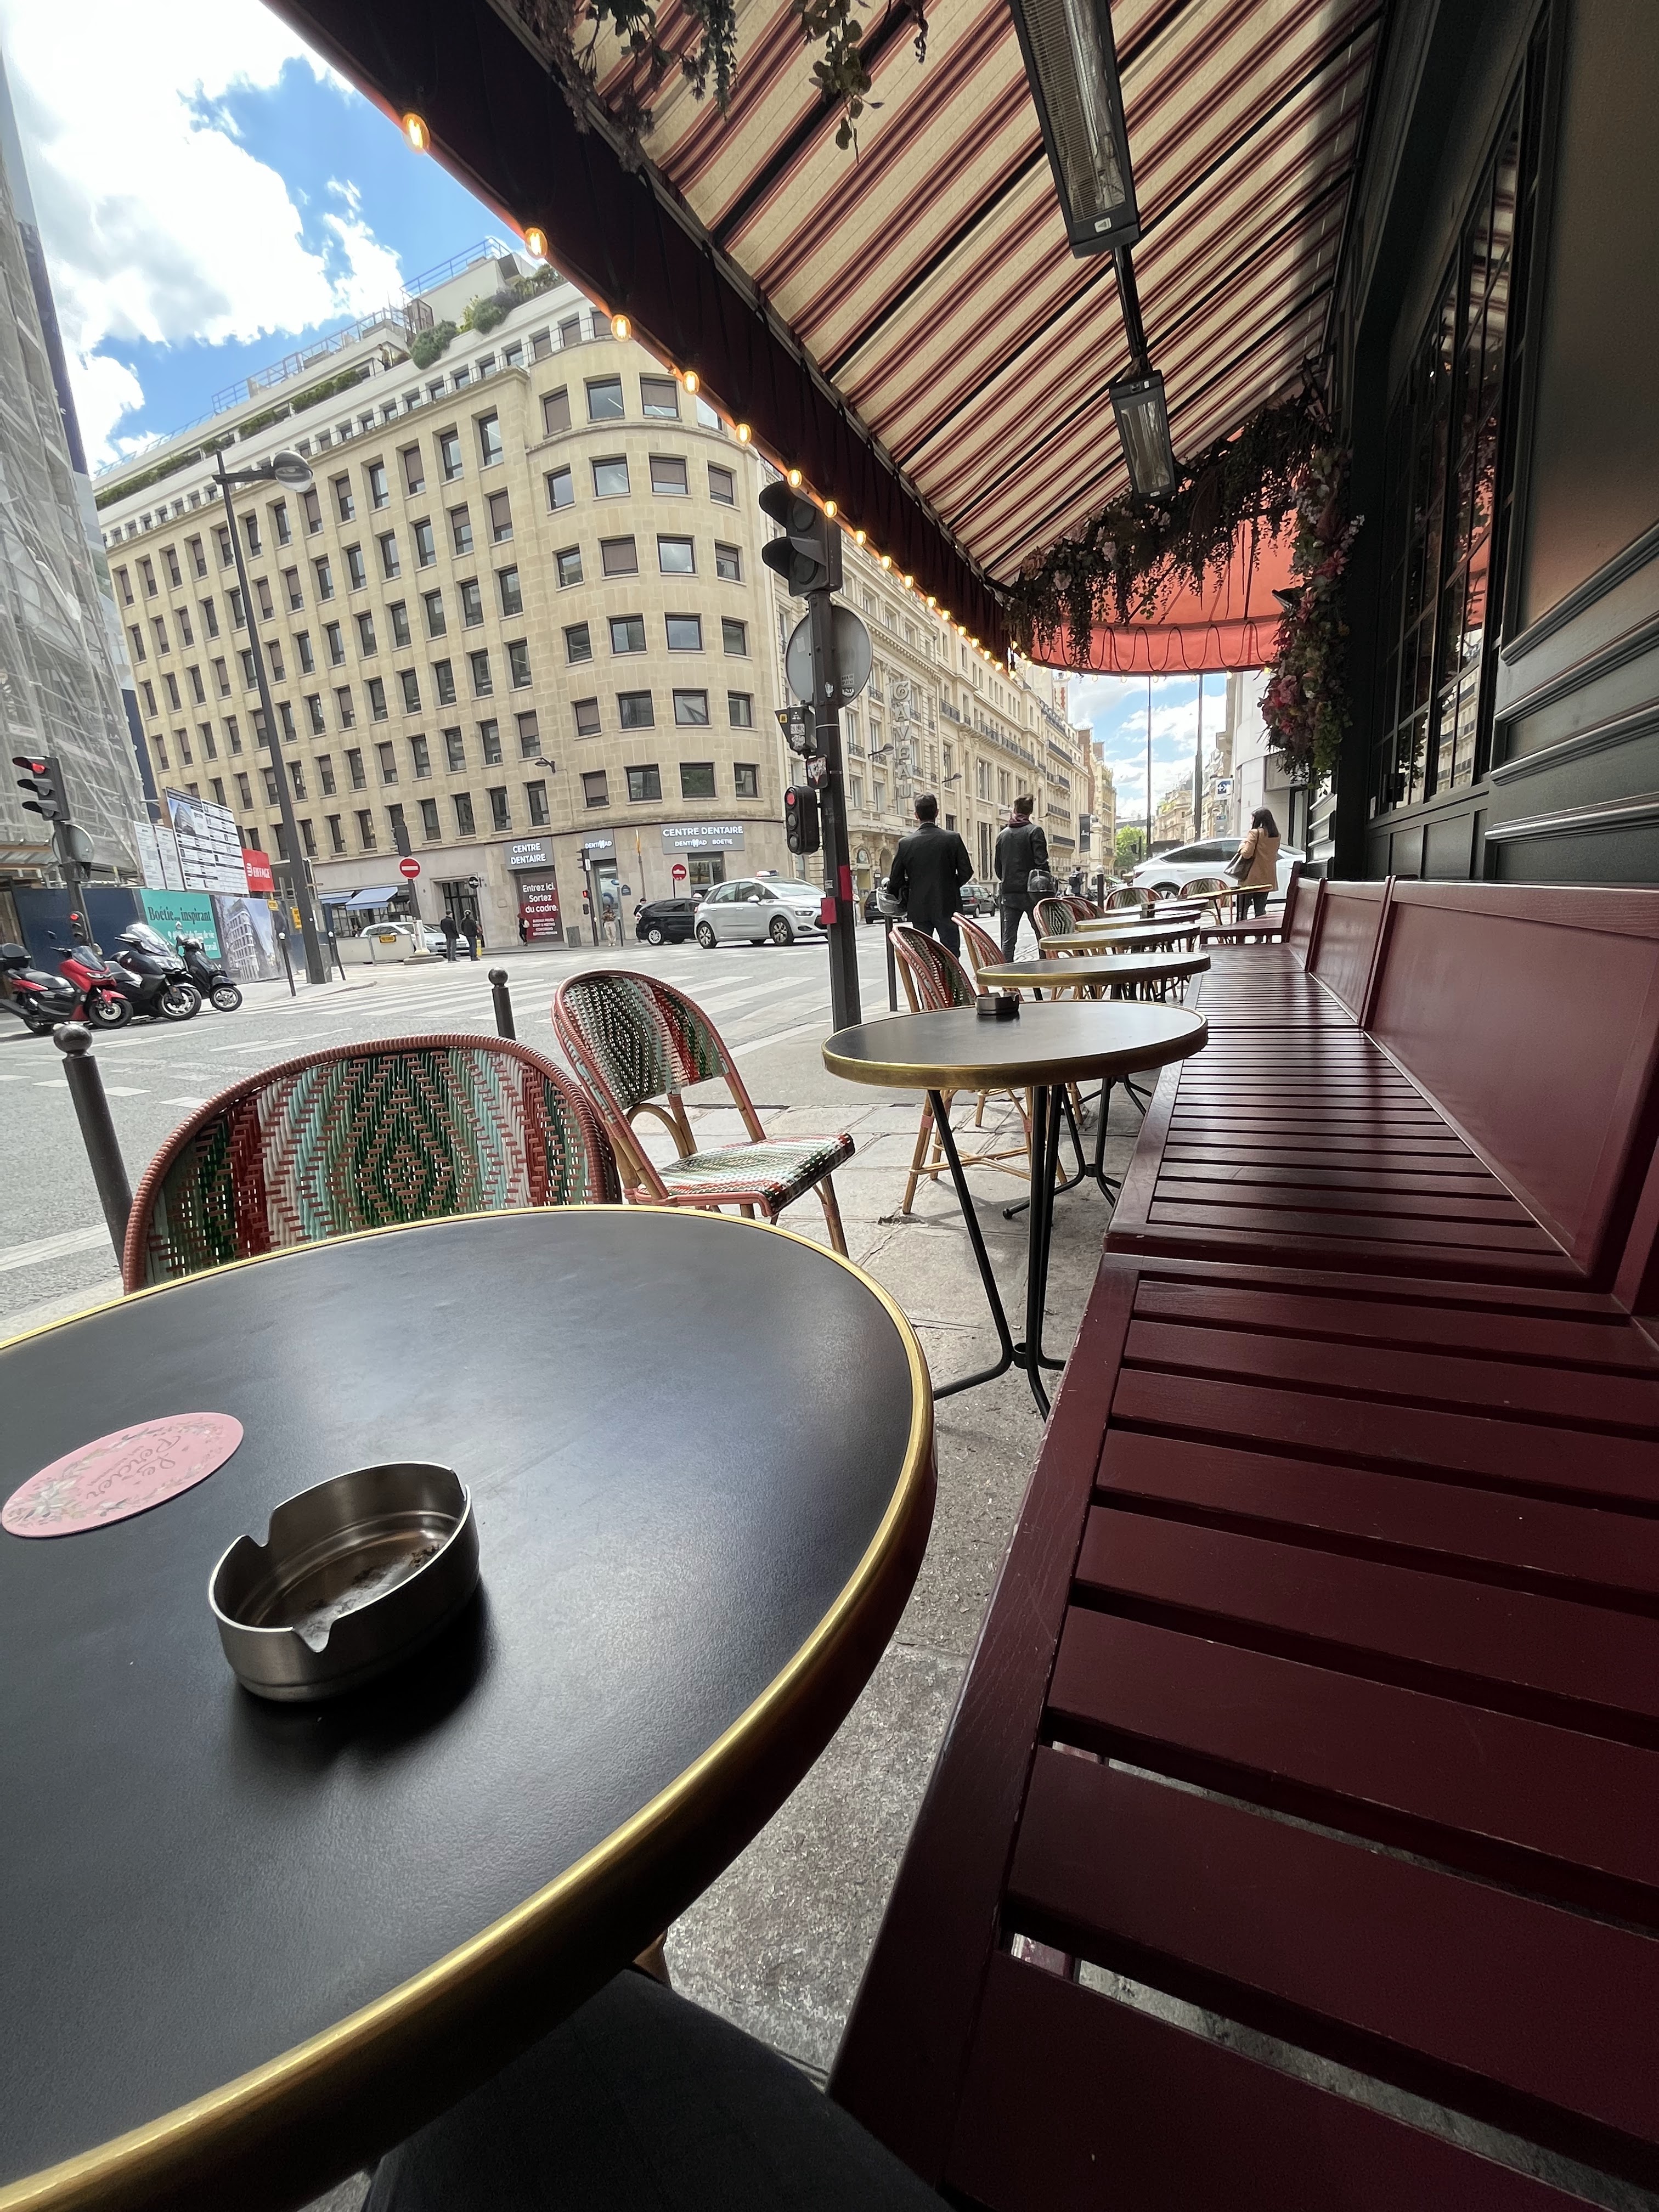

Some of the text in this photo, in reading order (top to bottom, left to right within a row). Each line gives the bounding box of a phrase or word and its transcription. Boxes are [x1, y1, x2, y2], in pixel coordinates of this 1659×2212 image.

[893, 682, 912, 798] GAVEAU
[663, 826, 743, 837] CENTRE DENTAIRE
[512, 843, 541, 854] CENTRE
[510, 853, 546, 865] DENTAIRE
[252, 867, 271, 879] EIFFAGE
[522, 884, 545, 893] Entrez
[528, 894, 552, 902] Sortez
[525, 904, 559, 913] du cadre.
[180, 907, 212, 924] inspirant
[137, 1453, 176, 1476] Le
